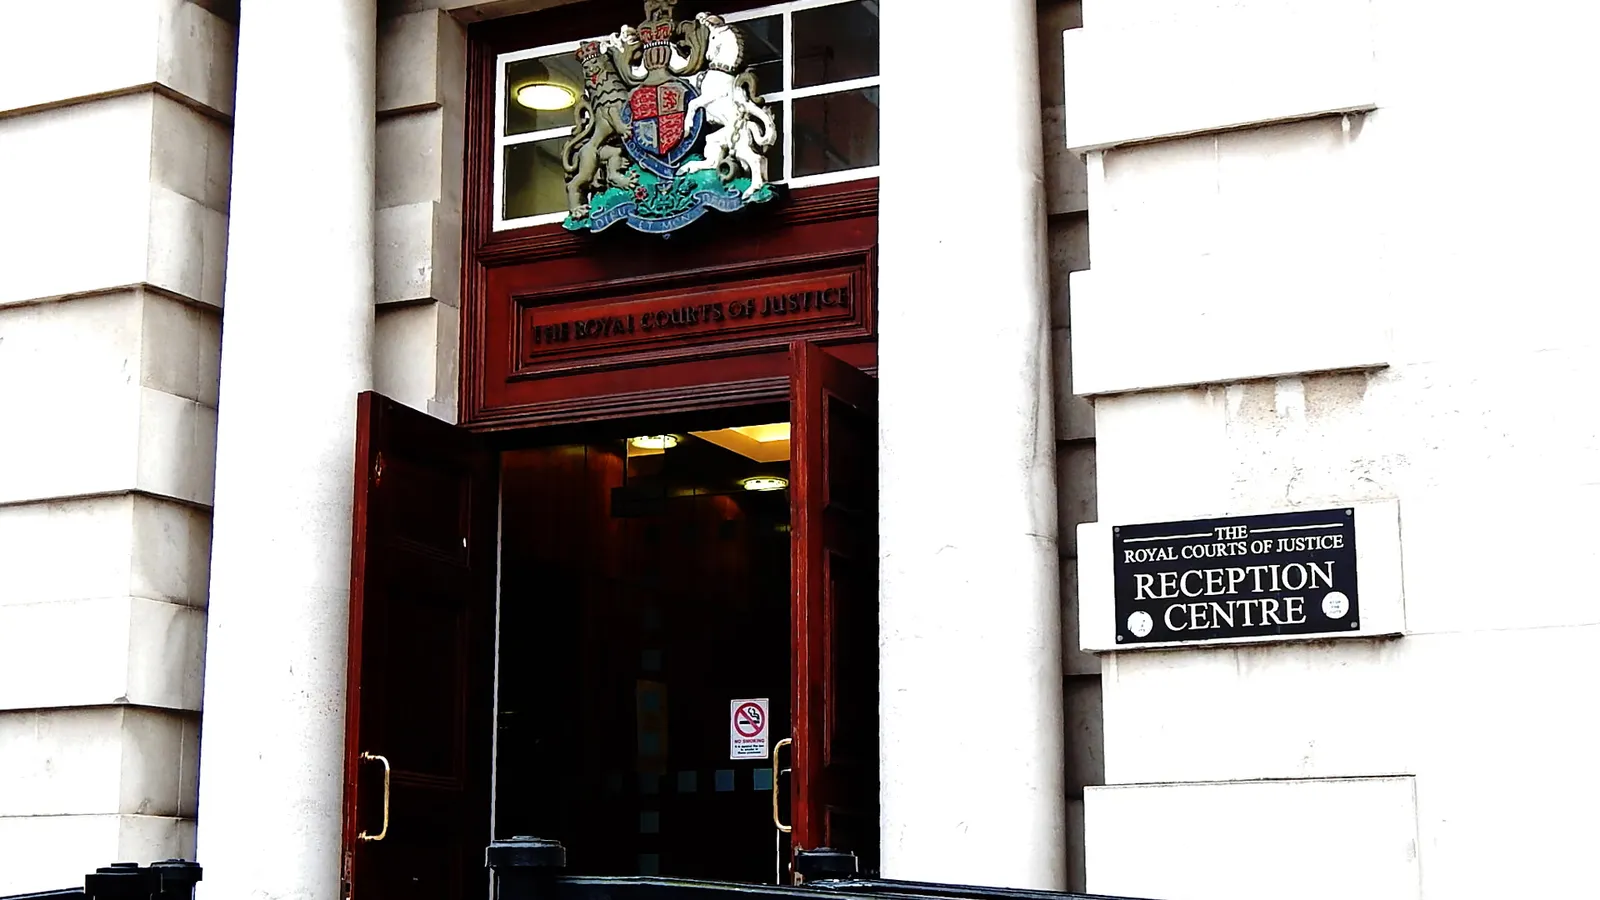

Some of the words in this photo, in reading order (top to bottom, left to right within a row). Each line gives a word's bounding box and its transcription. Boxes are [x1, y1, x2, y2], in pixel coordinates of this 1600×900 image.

[532, 320, 569, 344] THE
[574, 315, 634, 339] ROYAL
[640, 304, 726, 330] COURTS
[728, 299, 754, 319] OF
[760, 286, 849, 317] JUSTICE
[1124, 547, 1178, 564] ROYAL
[1181, 541, 1248, 559] COURTS
[1250, 539, 1273, 554] OF
[1276, 534, 1345, 553] JUSTICE
[1214, 525, 1248, 541] THE
[1133, 560, 1336, 601] RECEPTION
[1164, 596, 1307, 632] CENTRE
